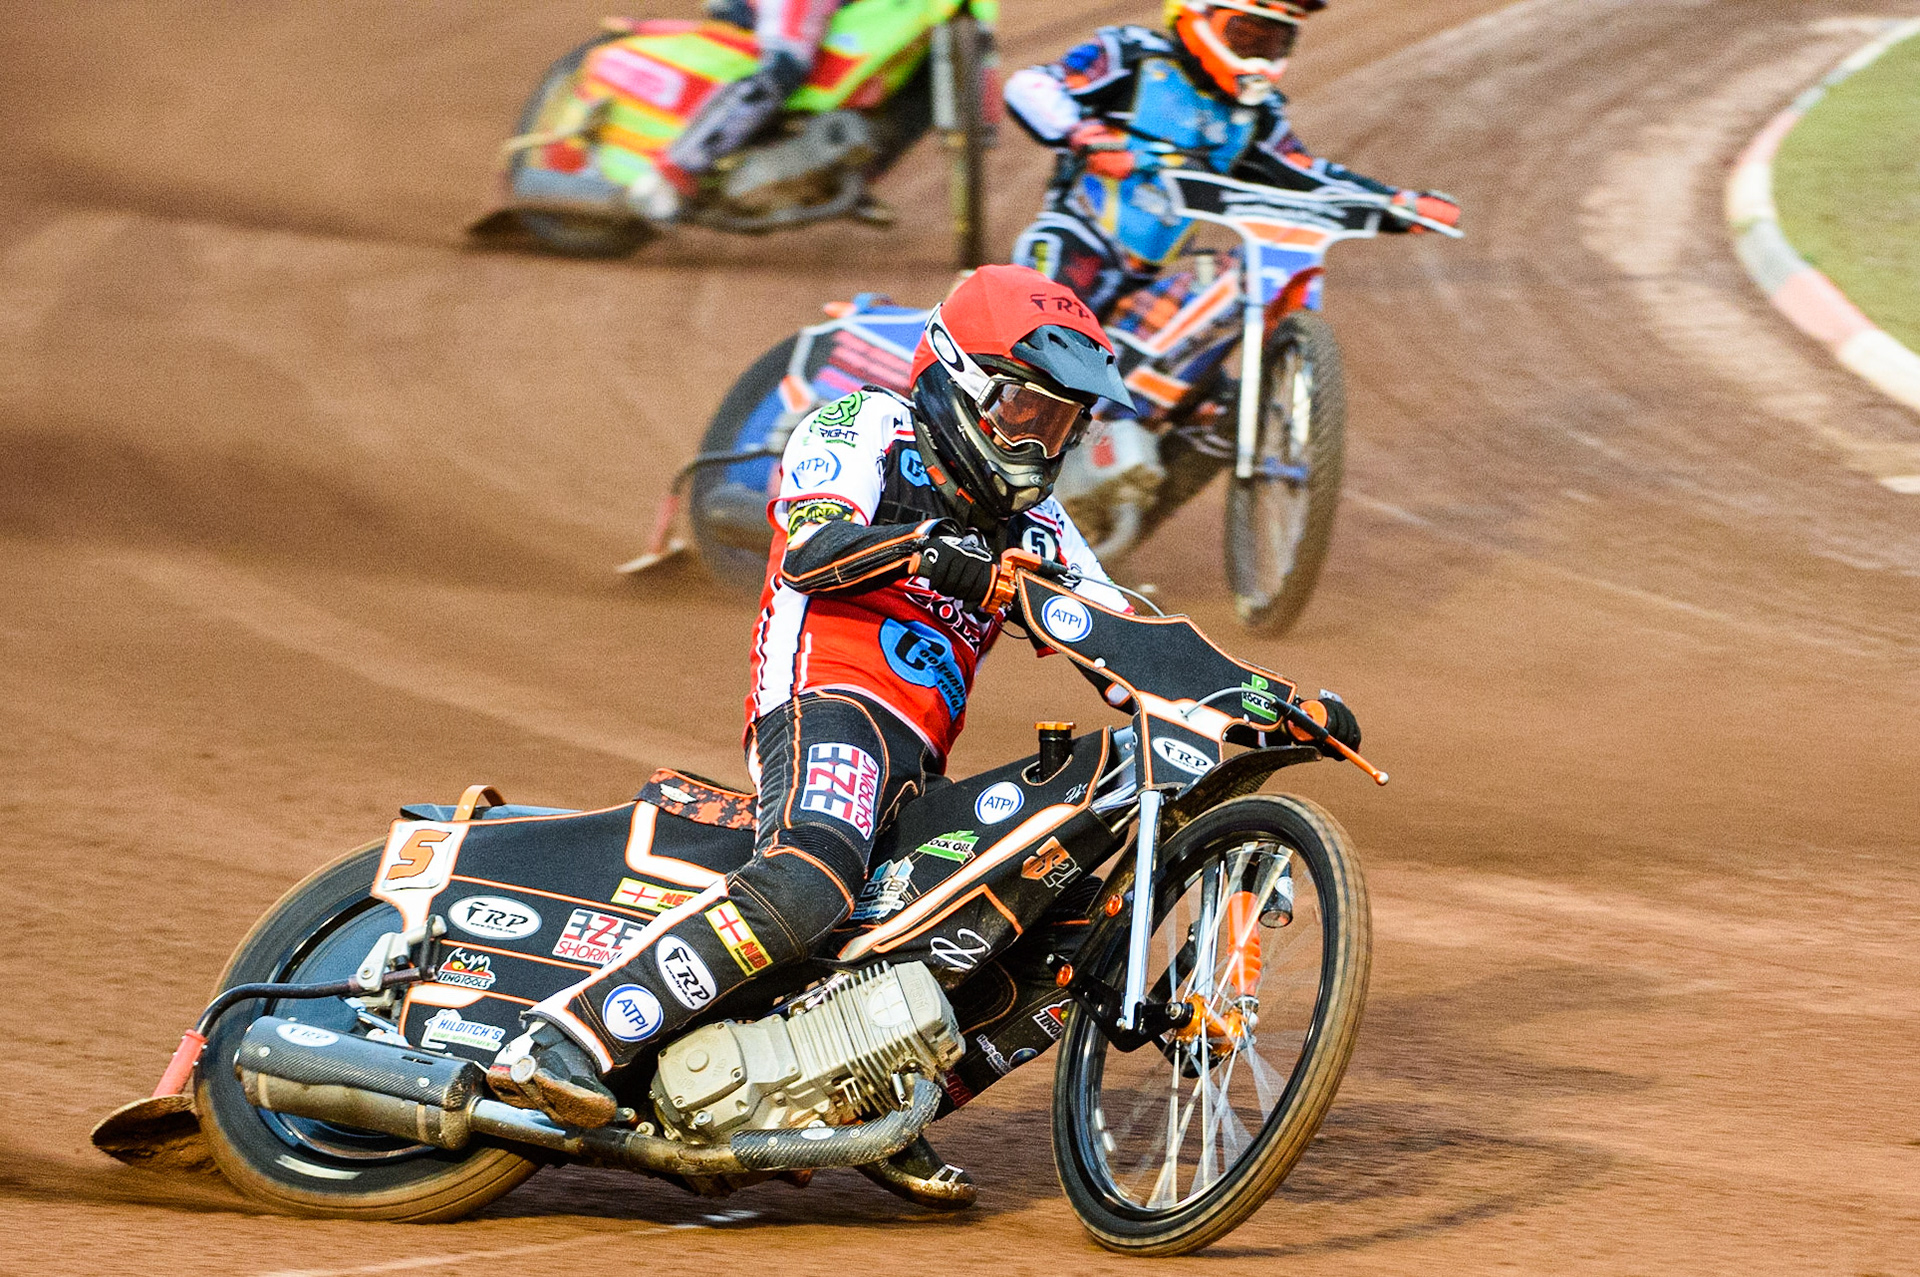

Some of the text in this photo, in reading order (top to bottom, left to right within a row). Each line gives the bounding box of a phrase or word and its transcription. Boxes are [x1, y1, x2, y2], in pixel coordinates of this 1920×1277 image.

[1030, 530, 1046, 559] 5
[1051, 608, 1083, 629] ATPI
[1164, 741, 1208, 767] FRP
[855, 754, 878, 837] SHORING
[984, 795, 1014, 811] ATPI
[466, 901, 529, 928] FRP
[556, 940, 618, 961] SHORIN
[664, 946, 711, 1000] FRP
[617, 998, 649, 1031] ATPI
[438, 1020, 502, 1040] HILDITCH'S
